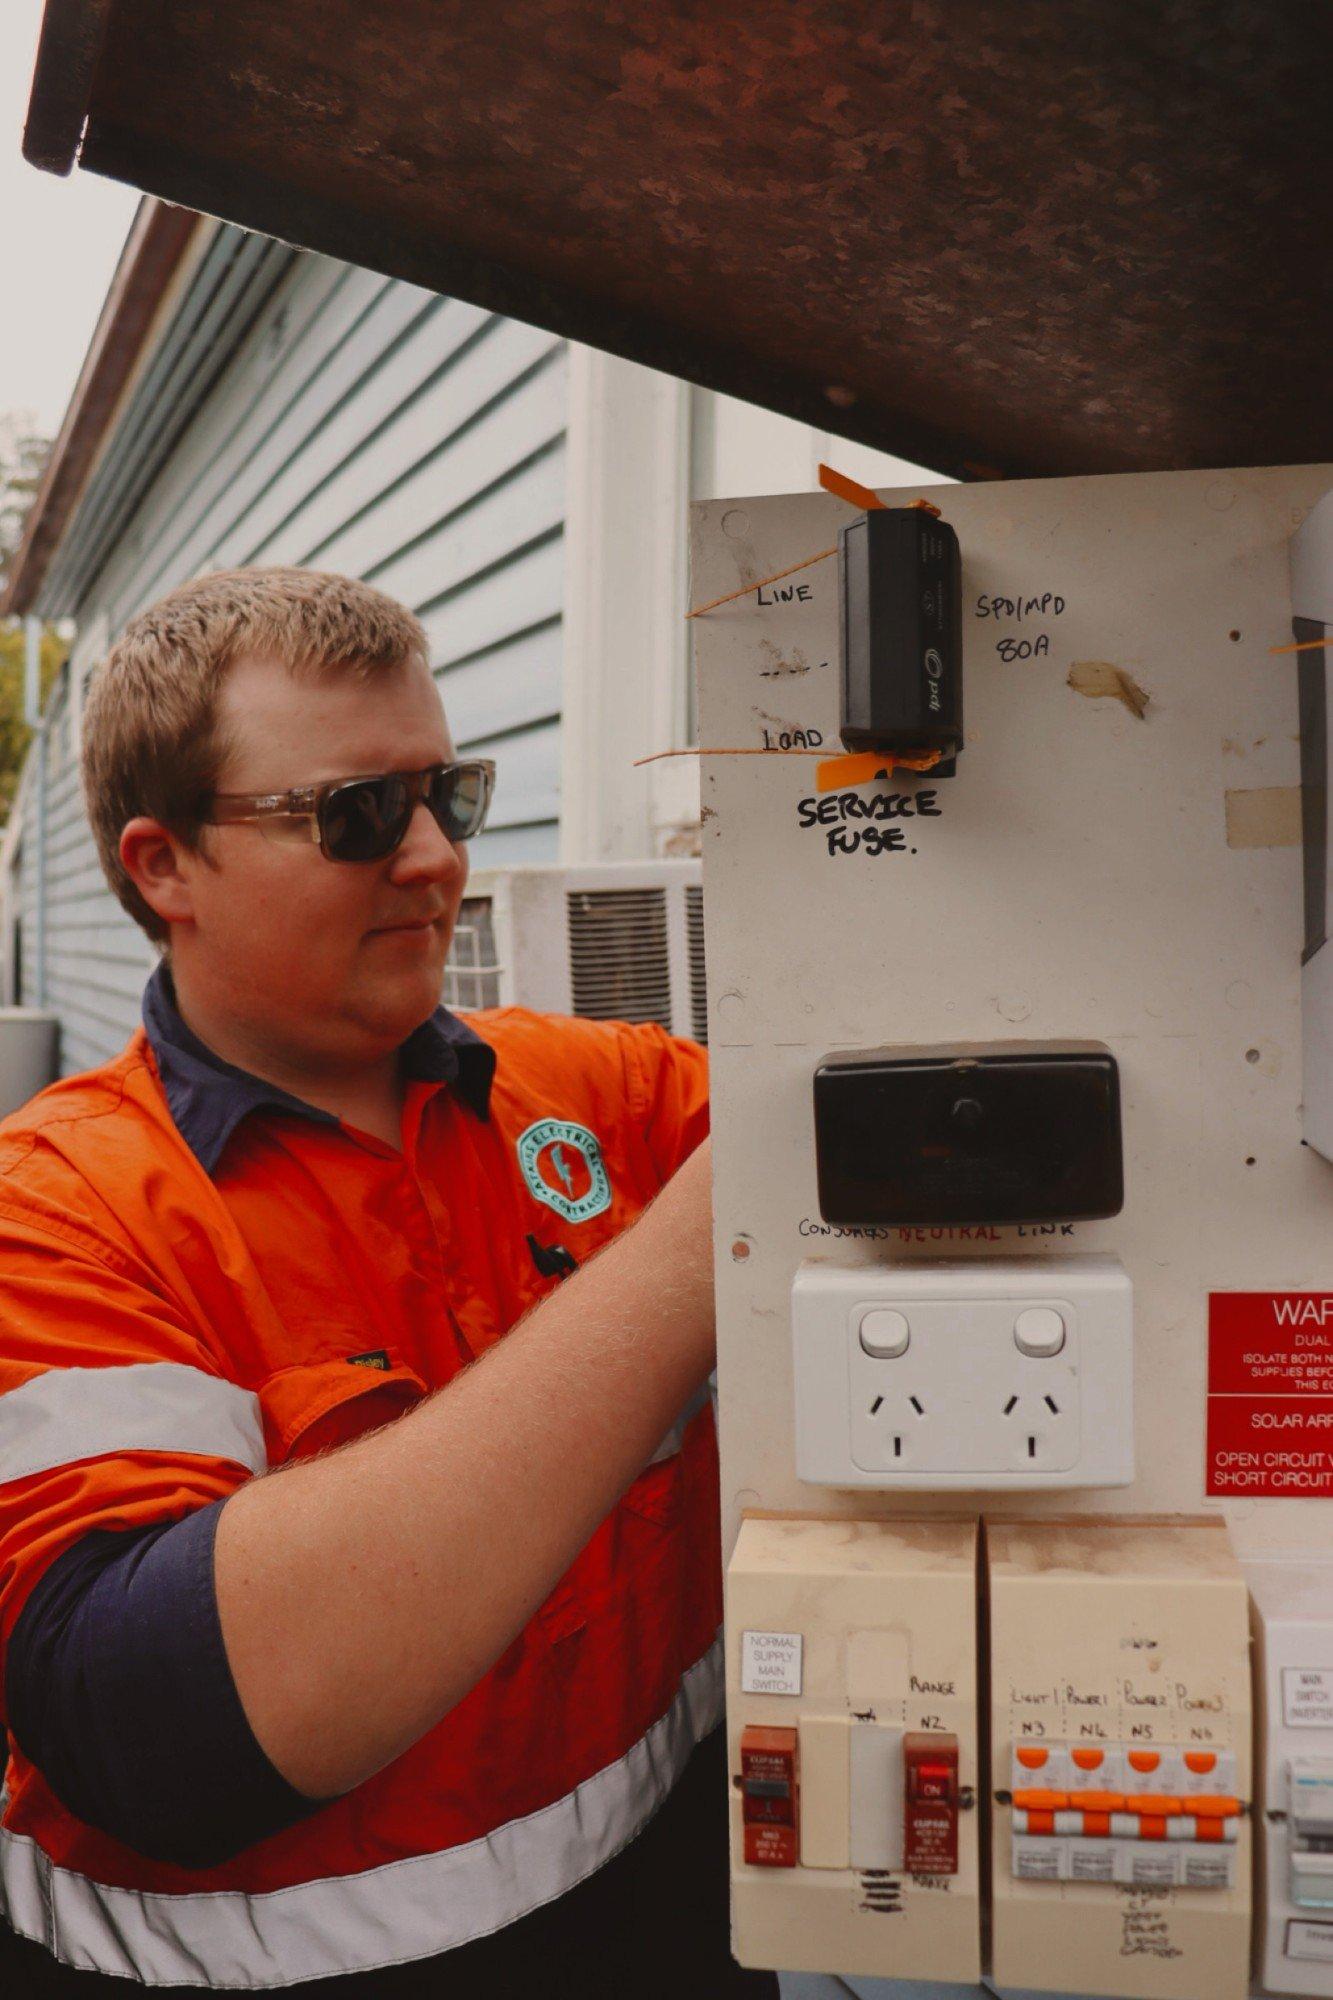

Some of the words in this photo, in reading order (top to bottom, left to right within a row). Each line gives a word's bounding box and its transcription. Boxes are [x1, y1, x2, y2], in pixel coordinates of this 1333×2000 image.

[757, 585, 813, 606] LINE
[996, 634, 1049, 662] 80A
[763, 729, 823, 751] LOAD
[797, 790, 942, 828] SERVICE
[1018, 1224, 1074, 1237] LINK
[1295, 1334, 1330, 1346] DUAL
[1243, 1353, 1288, 1364] ISOLATE
[1290, 1353, 1321, 1364] BOTH
[1251, 1366, 1304, 1378] SUPPLIES
[1294, 1379, 1319, 1390] THIS
[1251, 1413, 1304, 1429] SOLAR
[1215, 1451, 1259, 1467] OPEN
[1263, 1452, 1325, 1468] CIRCUIT
[1213, 1470, 1267, 1486] SHORT
[1270, 1471, 1333, 1487] CIRCUIT
[752, 1650, 793, 1662] SUPPLY
[758, 1665, 786, 1677] MAIN
[910, 1676, 955, 1696] RANGE
